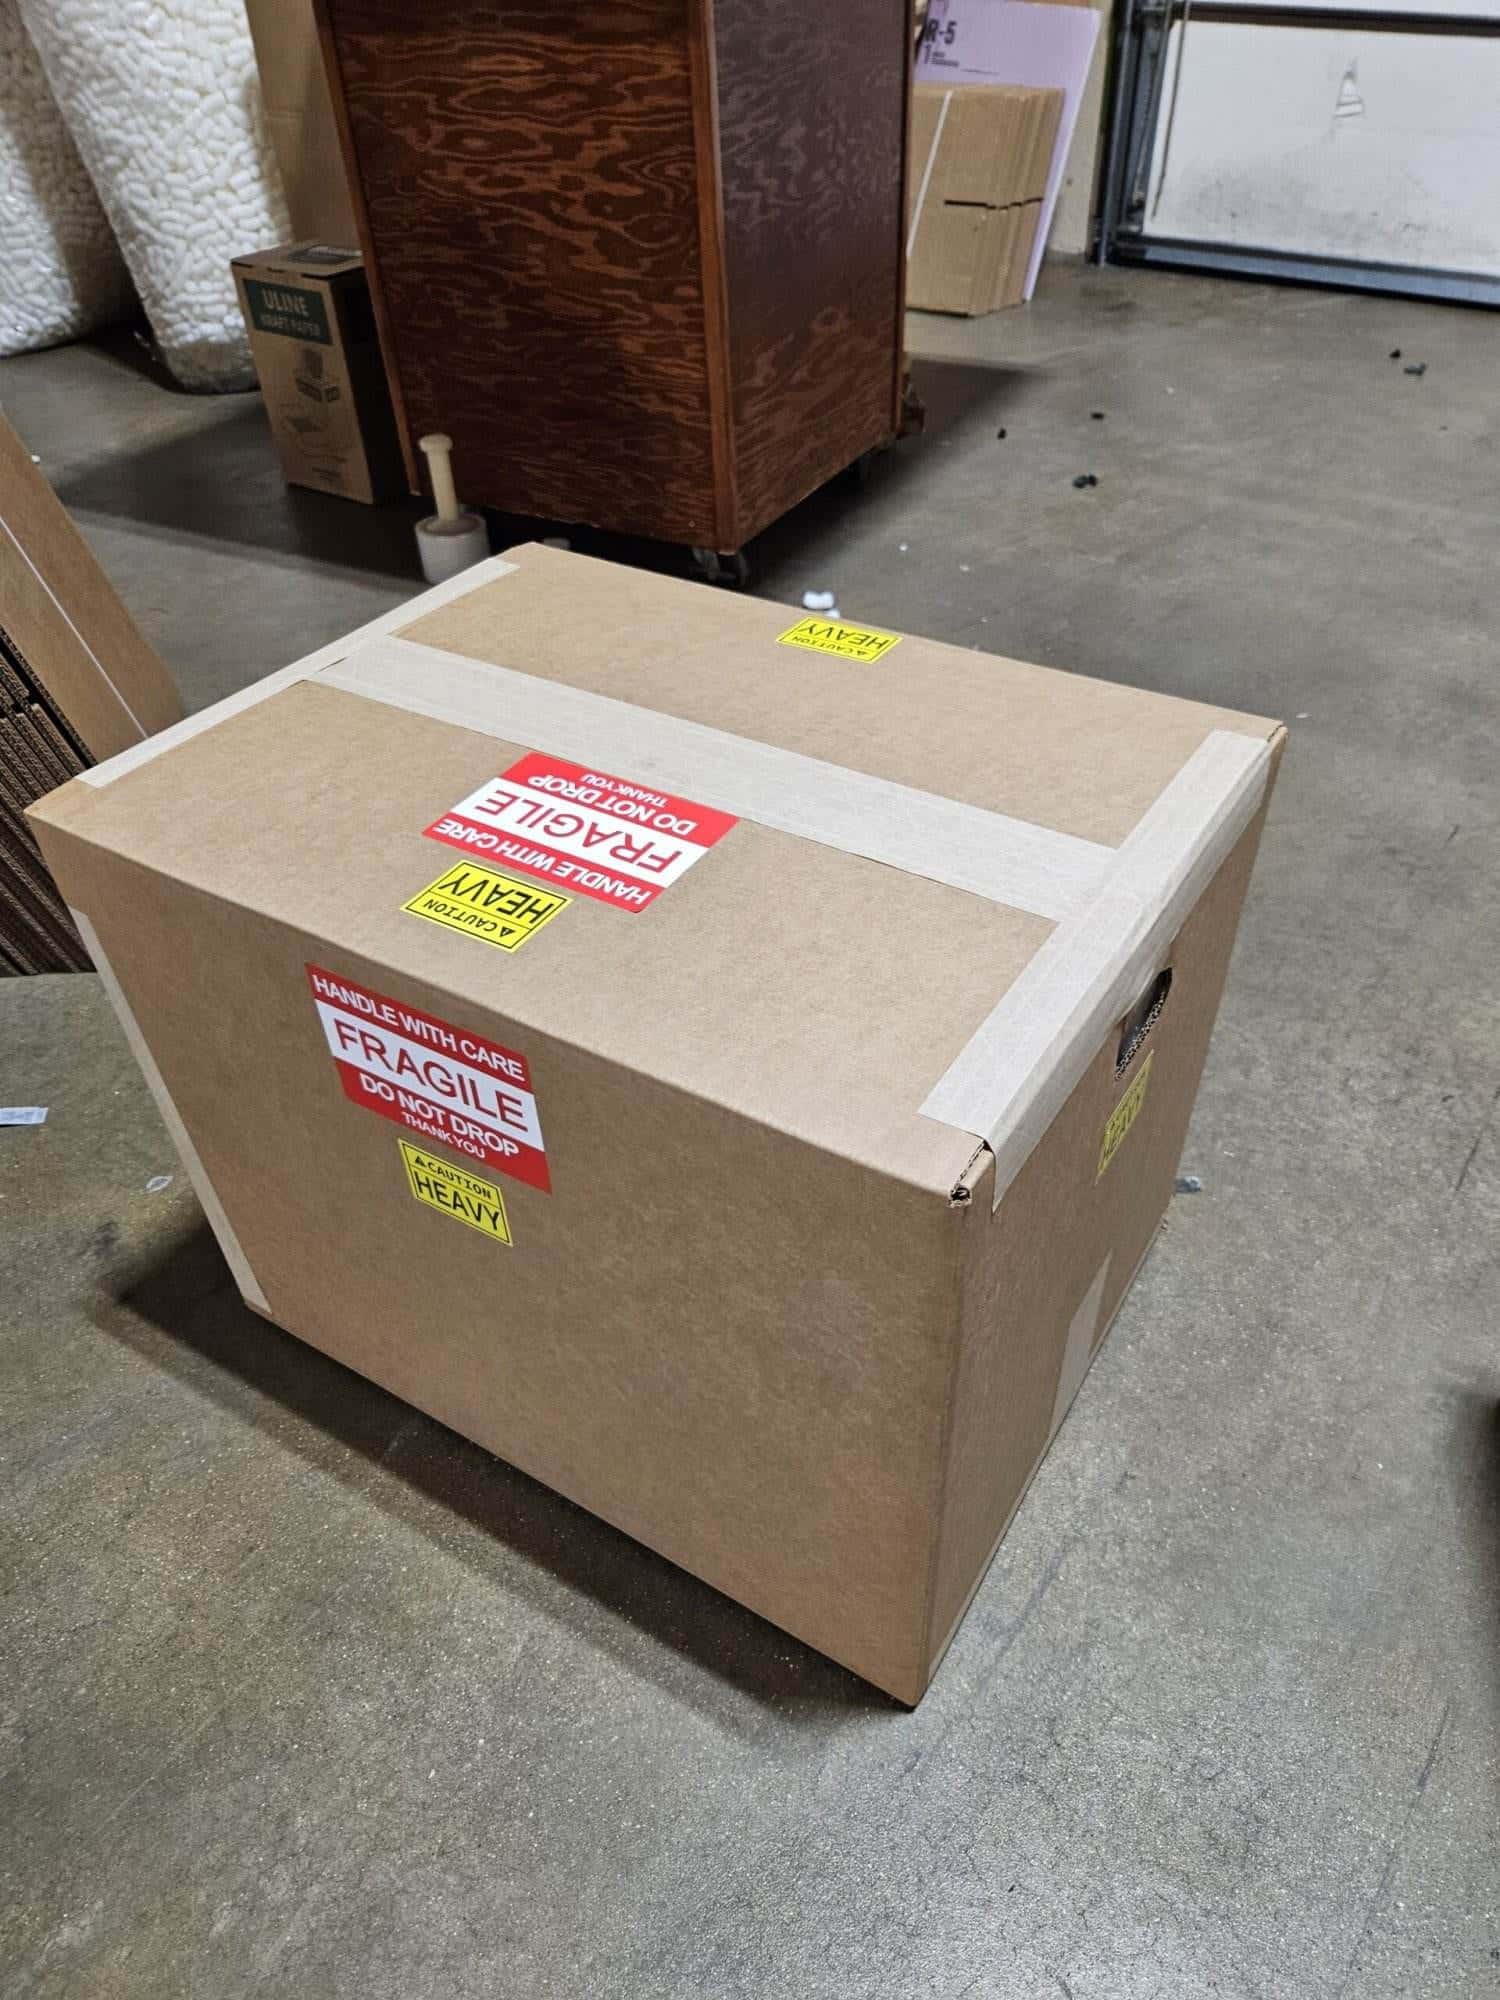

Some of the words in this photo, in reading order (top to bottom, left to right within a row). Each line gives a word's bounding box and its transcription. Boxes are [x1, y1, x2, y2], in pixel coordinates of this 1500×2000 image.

[261, 287, 309, 317] ULINE
[792, 635, 855, 655] CAUTION
[798, 623, 890, 649] HEAVY
[527, 774, 603, 805] DROP
[580, 773, 616, 791] YOU
[615, 782, 669, 808] THANK
[595, 795, 656, 823] NOT
[652, 813, 698, 836] DO
[432, 818, 500, 849] CARE
[475, 789, 682, 874] FRAGILE
[493, 840, 557, 872] WITH
[438, 872, 554, 924] HEAVY
[552, 861, 653, 905] HANDLE
[423, 898, 497, 933] CAUTION
[312, 974, 399, 1027] HANDLE
[399, 1010, 458, 1052] WITH
[460, 1039, 526, 1082] CARE
[334, 1018, 529, 1133] FRAGILE
[359, 1073, 396, 1102] DO
[399, 1089, 445, 1127] NOT
[449, 1112, 520, 1158] DROP
[402, 1111, 454, 1145] THANK
[452, 1132, 486, 1159] YOU
[426, 1159, 492, 1201] CAUTION
[415, 1171, 501, 1231] HEAVY
